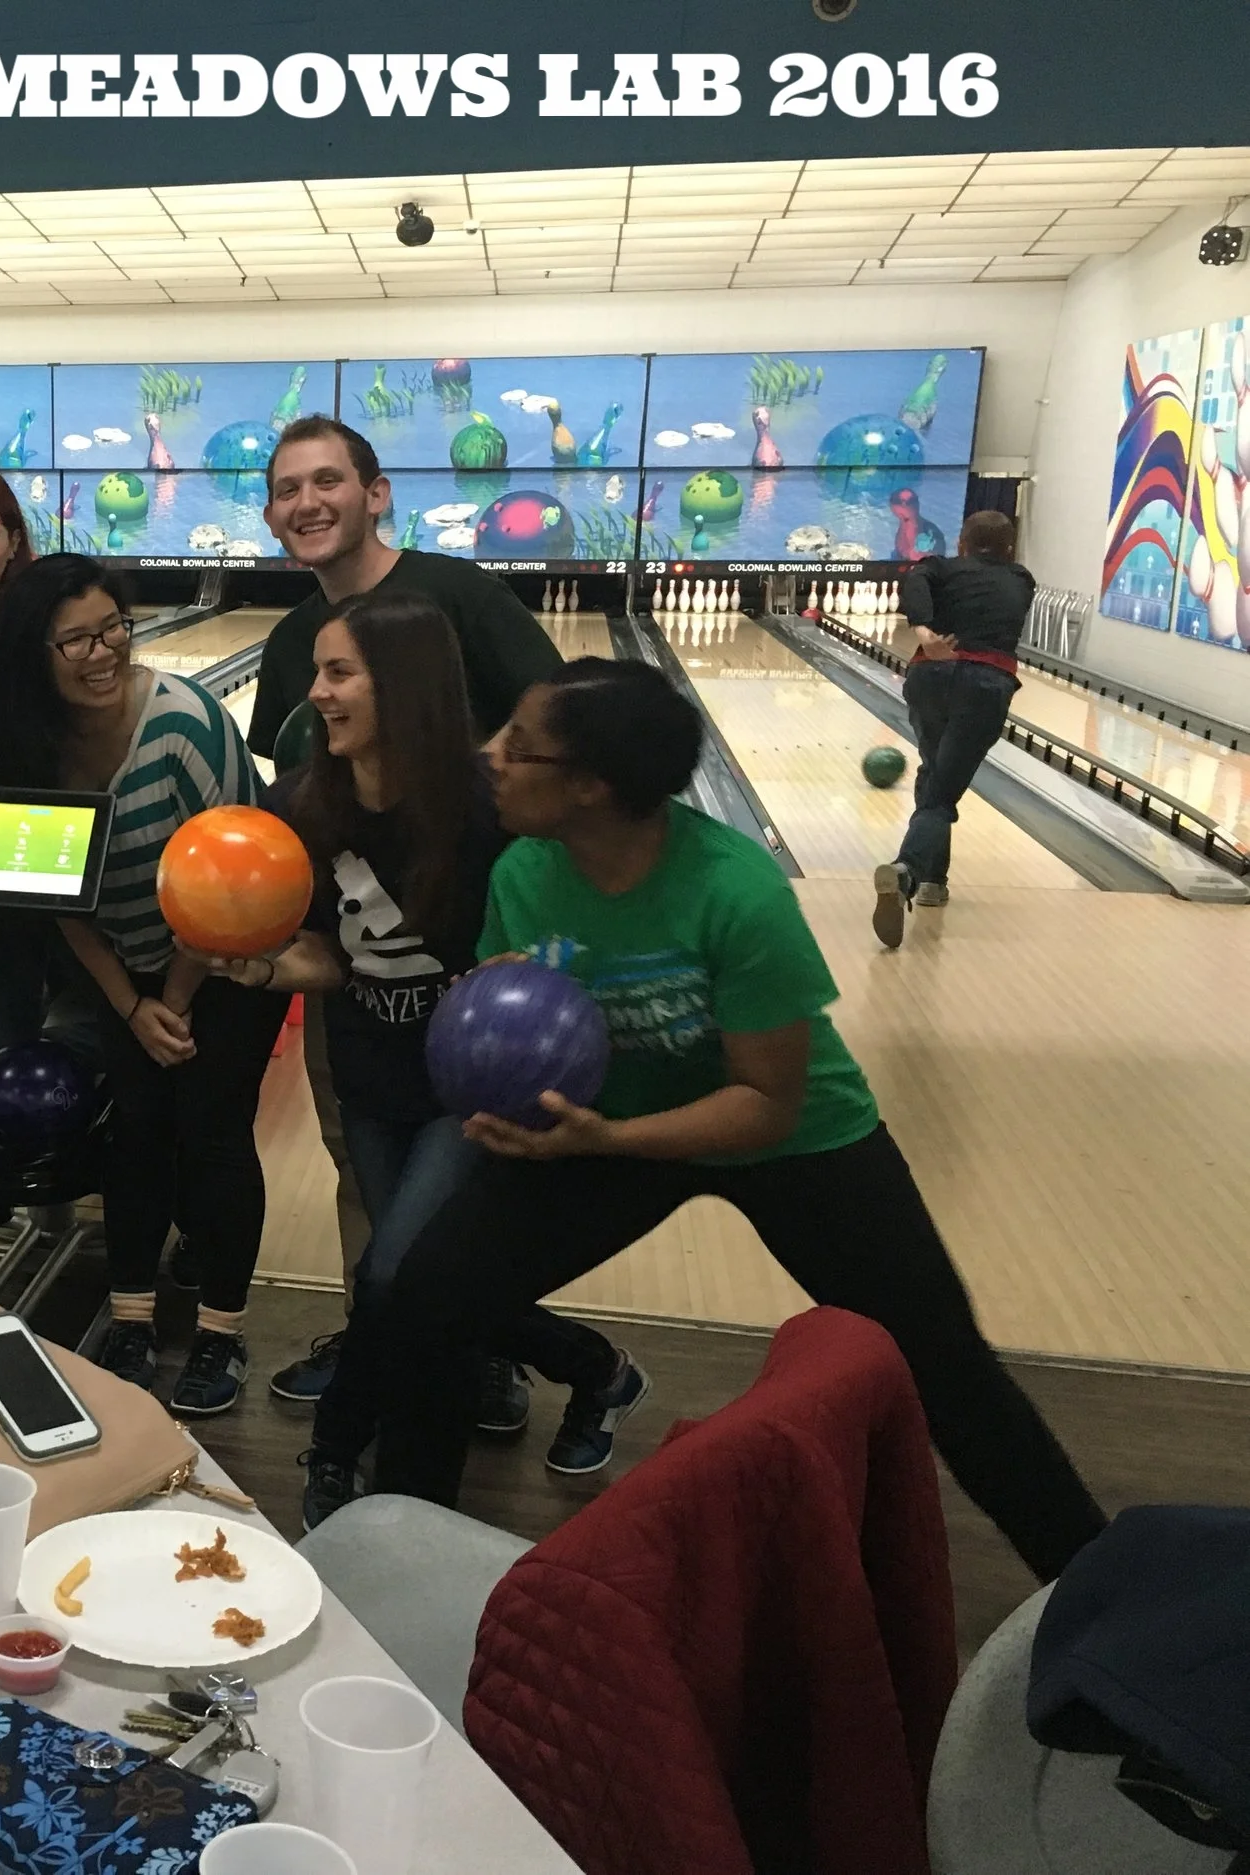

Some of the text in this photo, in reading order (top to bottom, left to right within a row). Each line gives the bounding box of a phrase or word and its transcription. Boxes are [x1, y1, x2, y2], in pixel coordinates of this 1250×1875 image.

[140, 559, 256, 568] COLONIAL BOWLING CENTER
[511, 562, 547, 571] CENTER
[605, 562, 627, 573] 22
[645, 562, 667, 574] 23
[728, 563, 863, 573] COLONIAL BOWLING CENTER
